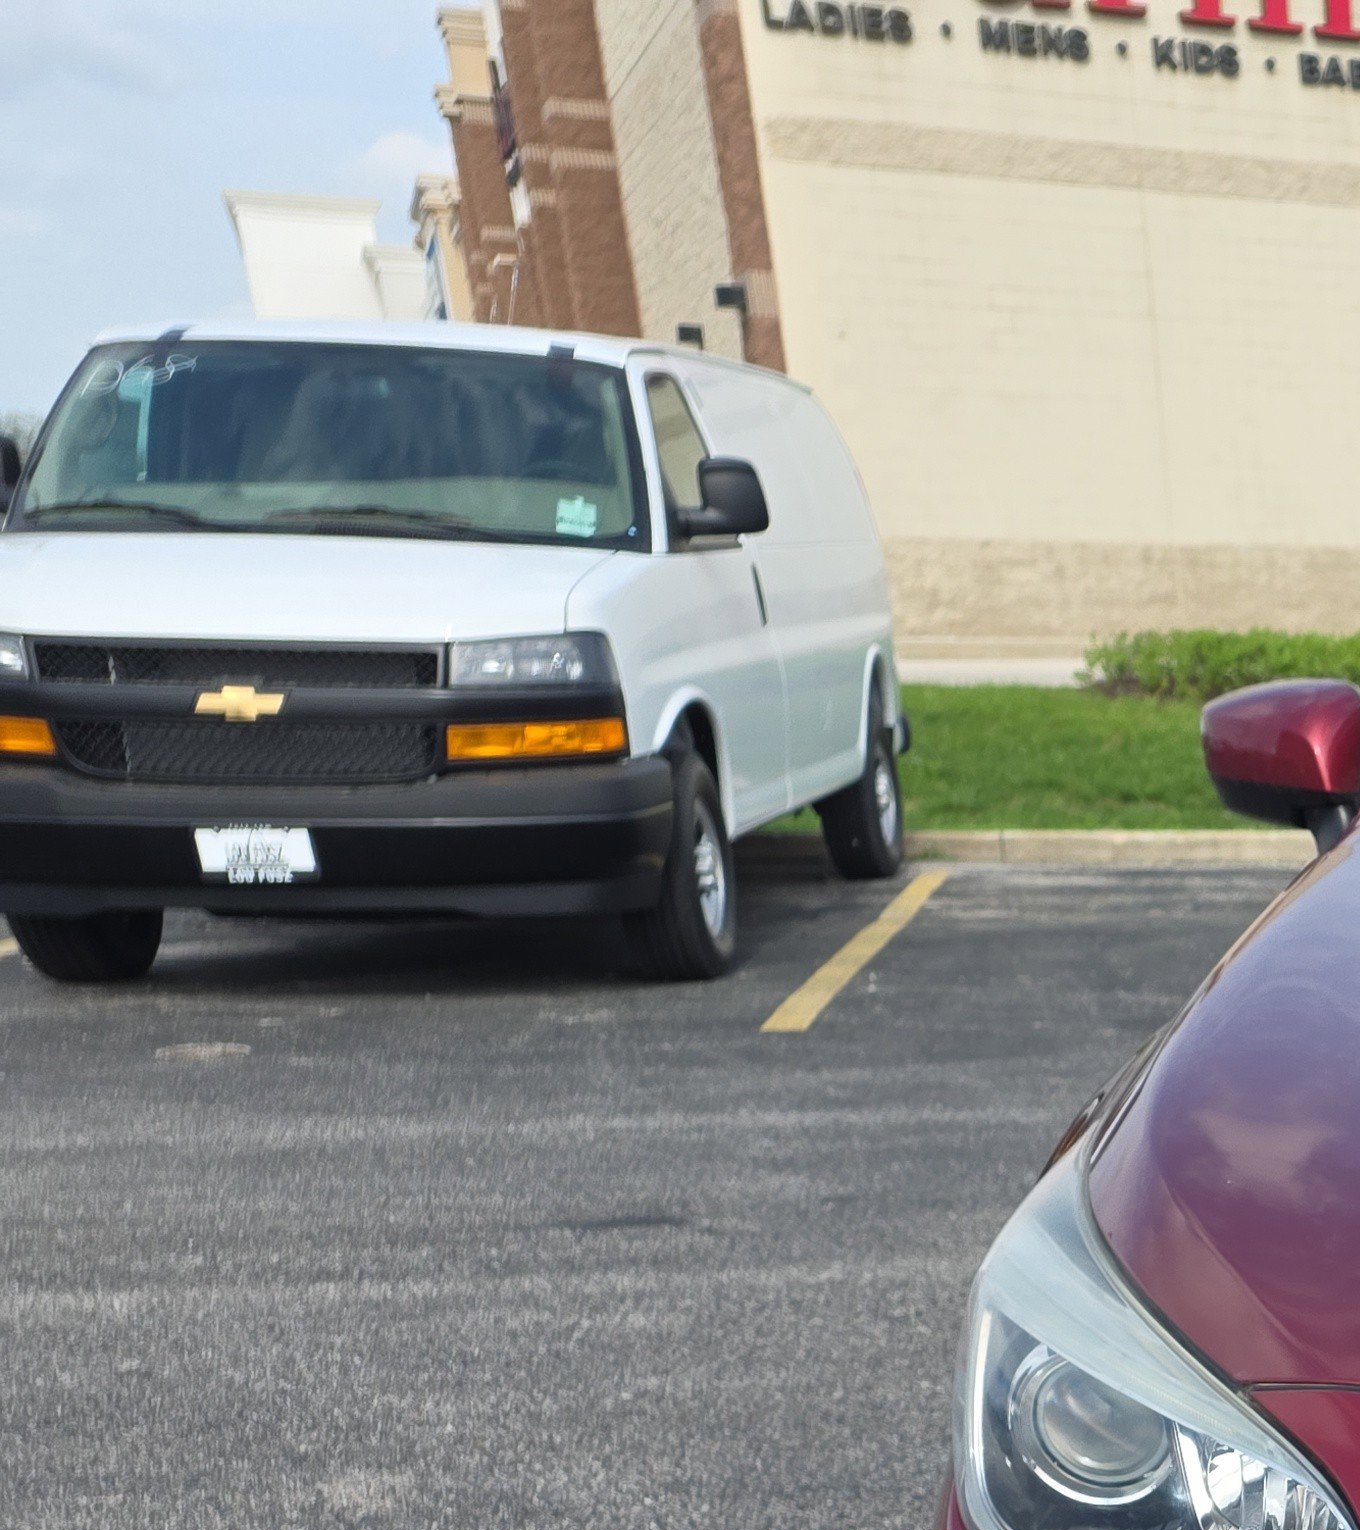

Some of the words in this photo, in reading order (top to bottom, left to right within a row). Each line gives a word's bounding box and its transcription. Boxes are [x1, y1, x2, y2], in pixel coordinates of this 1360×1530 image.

[762, 0, 914, 45] LADIES
[978, 16, 1090, 62] MENS
[1151, 36, 1240, 77] KIDS
